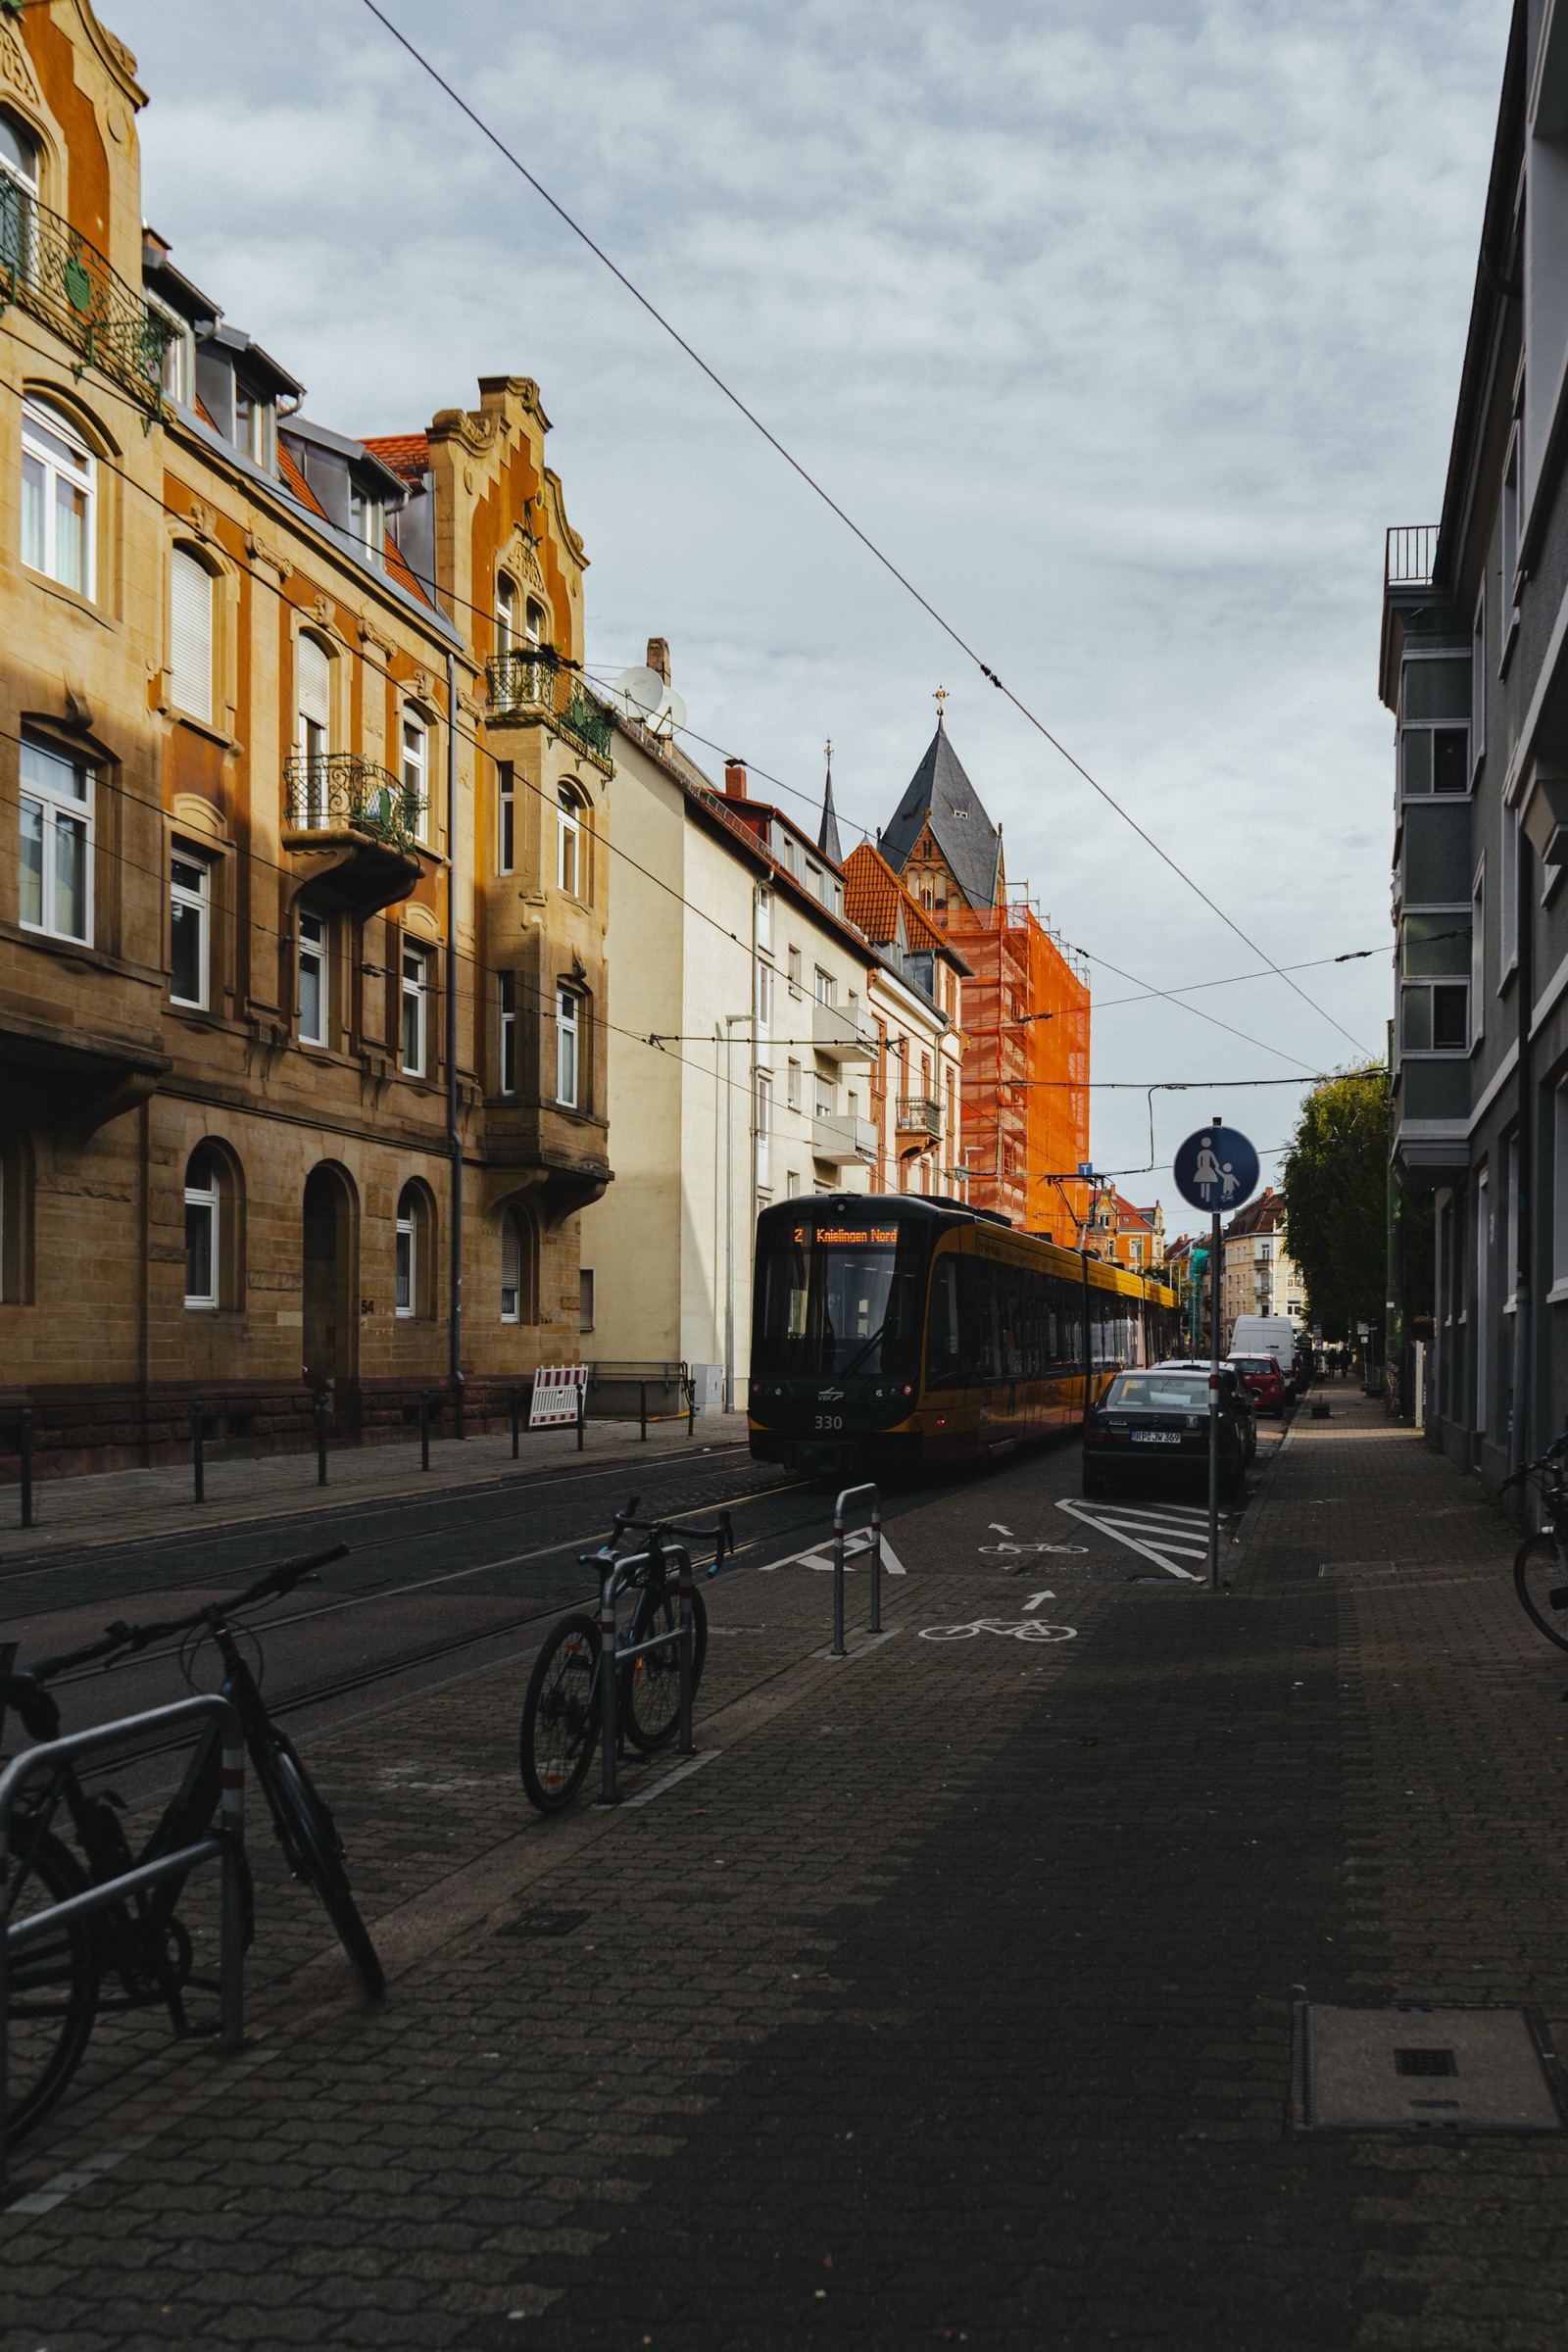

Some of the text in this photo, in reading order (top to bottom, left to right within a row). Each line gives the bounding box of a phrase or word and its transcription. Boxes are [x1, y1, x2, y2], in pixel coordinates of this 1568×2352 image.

[793, 1227, 898, 1243] 2 Knielingen Nord
[362, 1299, 373, 1314] 54
[814, 1415, 843, 1430] 330
[1136, 1432, 1180, 1442] RP JW 369
